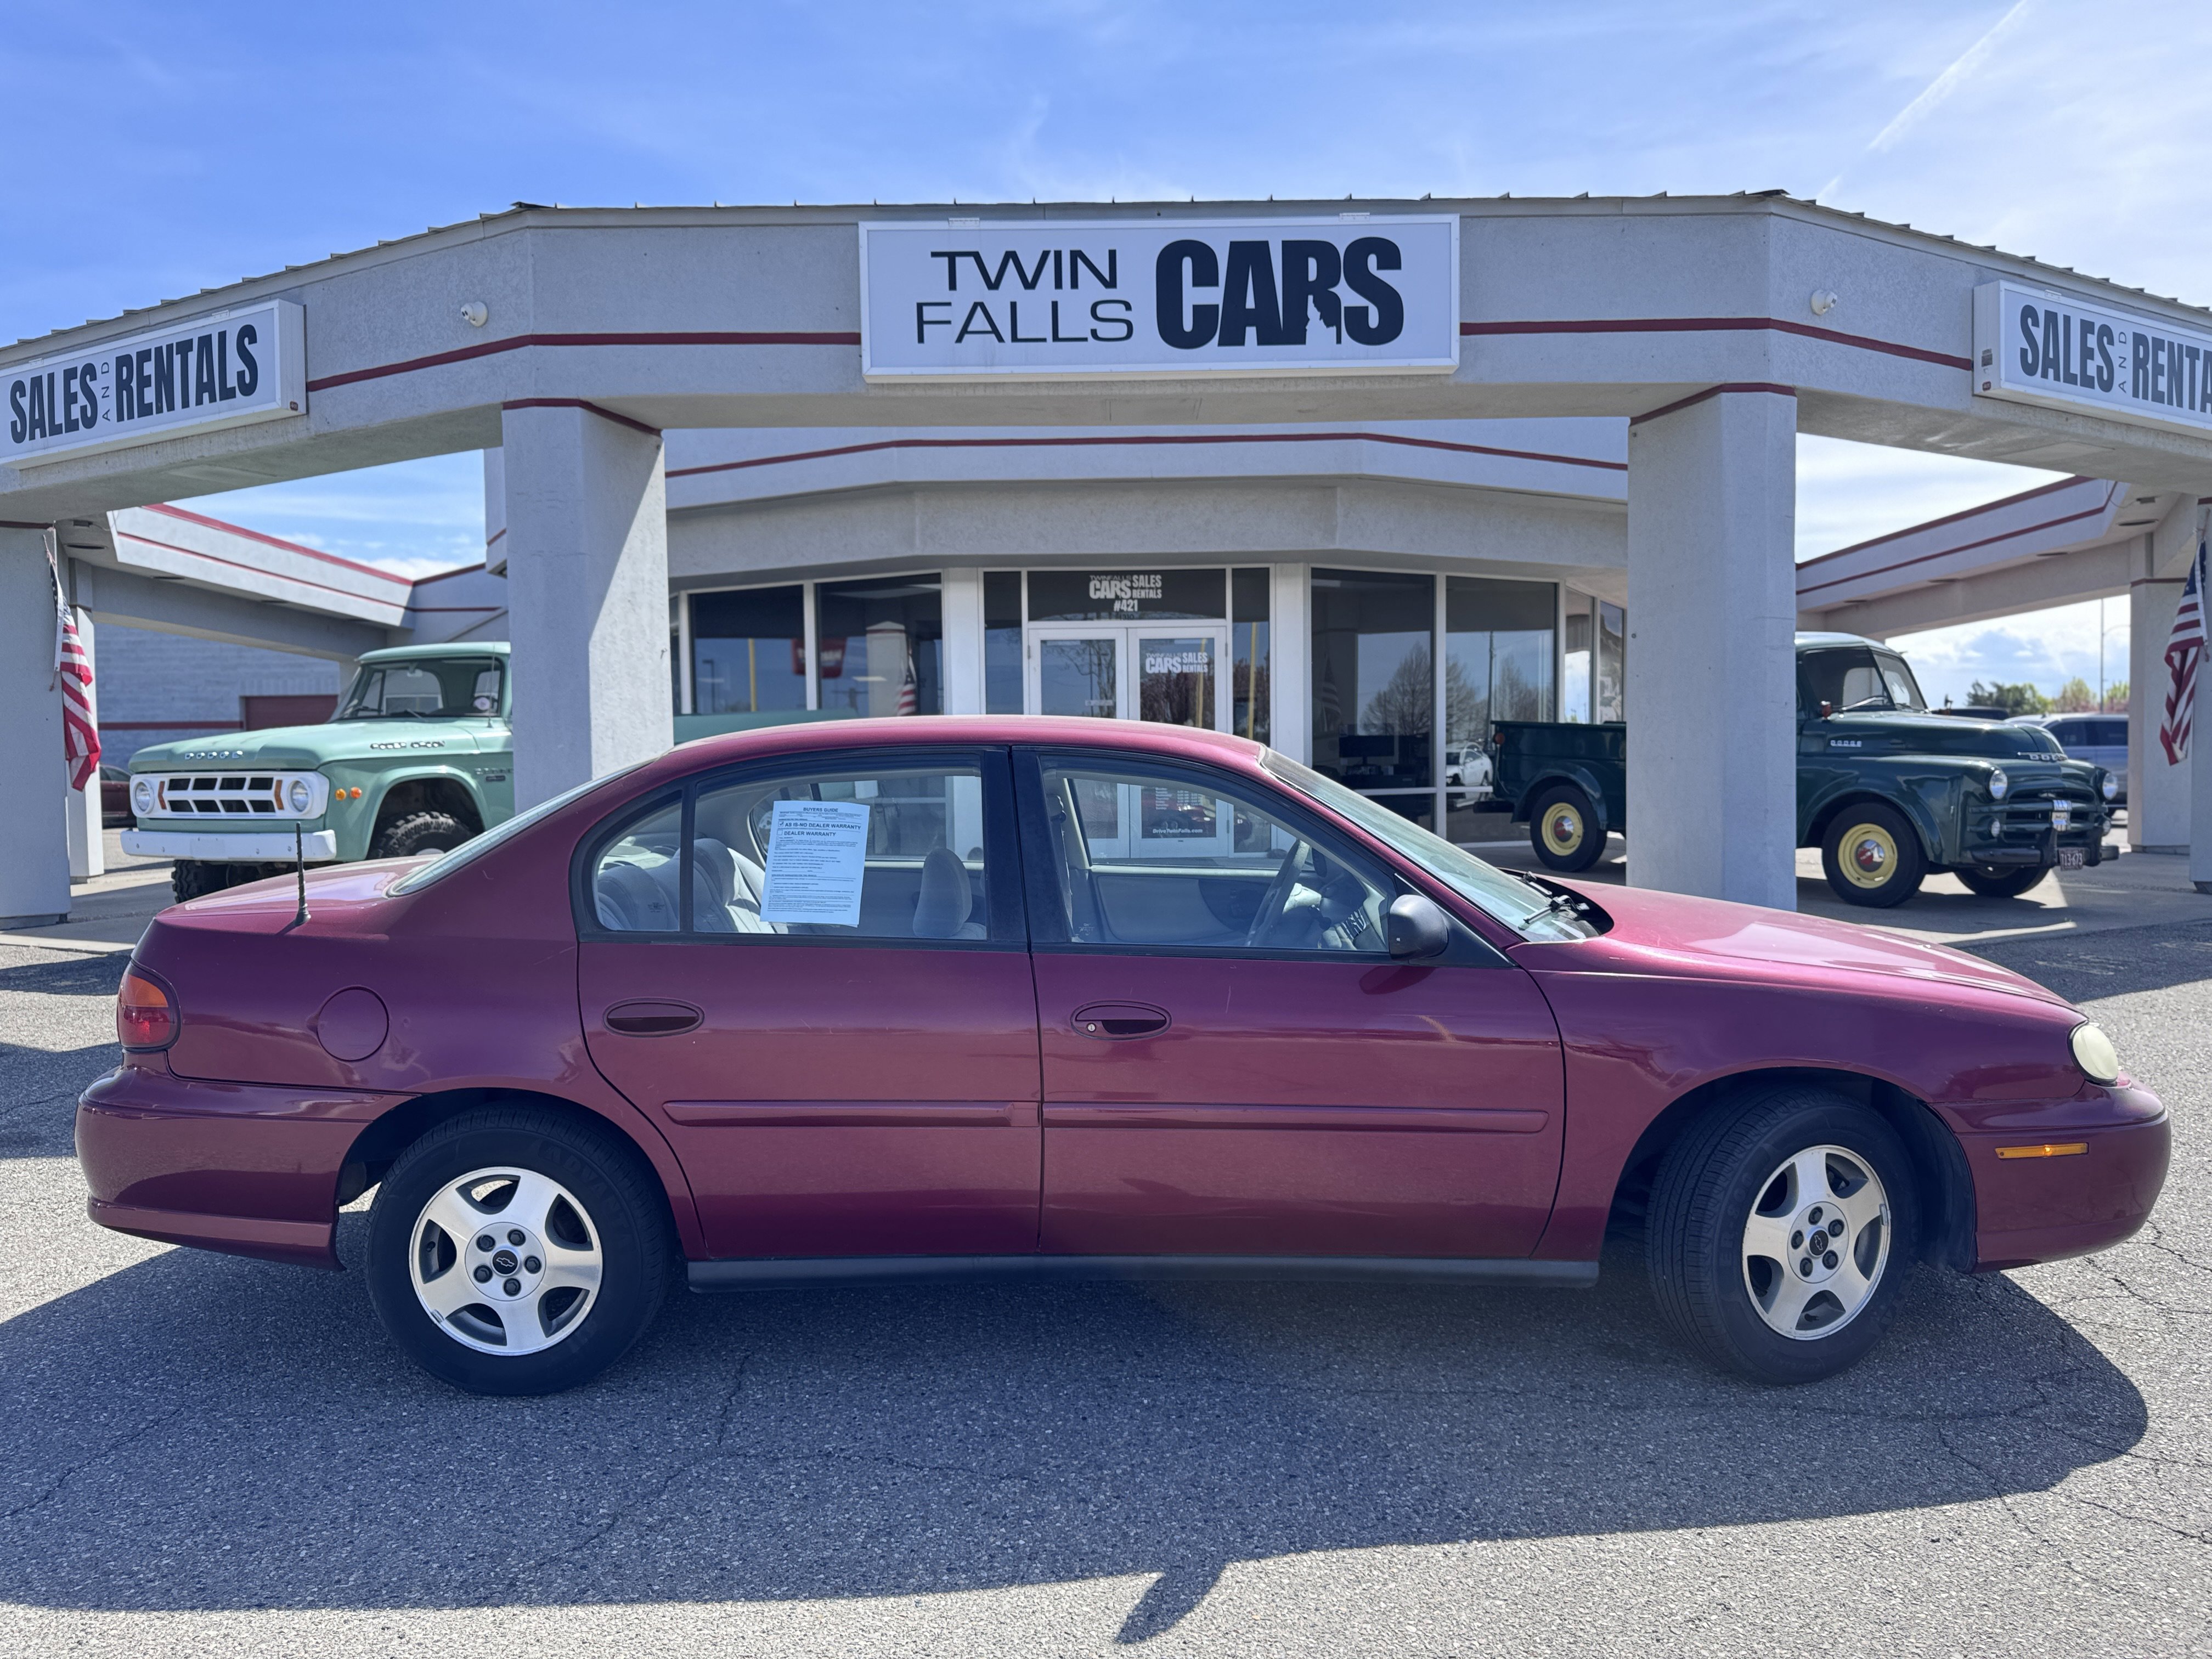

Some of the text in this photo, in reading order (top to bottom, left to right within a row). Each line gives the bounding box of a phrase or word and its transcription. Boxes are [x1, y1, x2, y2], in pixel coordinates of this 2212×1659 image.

[930, 249, 1117, 291] TWIN
[1156, 236, 1404, 349] CARS
[916, 299, 1134, 344] FALLS
[2020, 304, 2115, 393] SALES
[2119, 331, 2127, 393] AND
[10, 324, 258, 444] SALES AND RENTALS
[1089, 580, 1131, 599] CARS
[1132, 575, 1162, 588] SALES
[1132, 589, 1162, 599] RENTALS
[1113, 599, 1138, 612] #421
[1145, 657, 1182, 674] CARS
[1182, 652, 1207, 663] SALES
[1182, 664, 1208, 673] RENTALS
